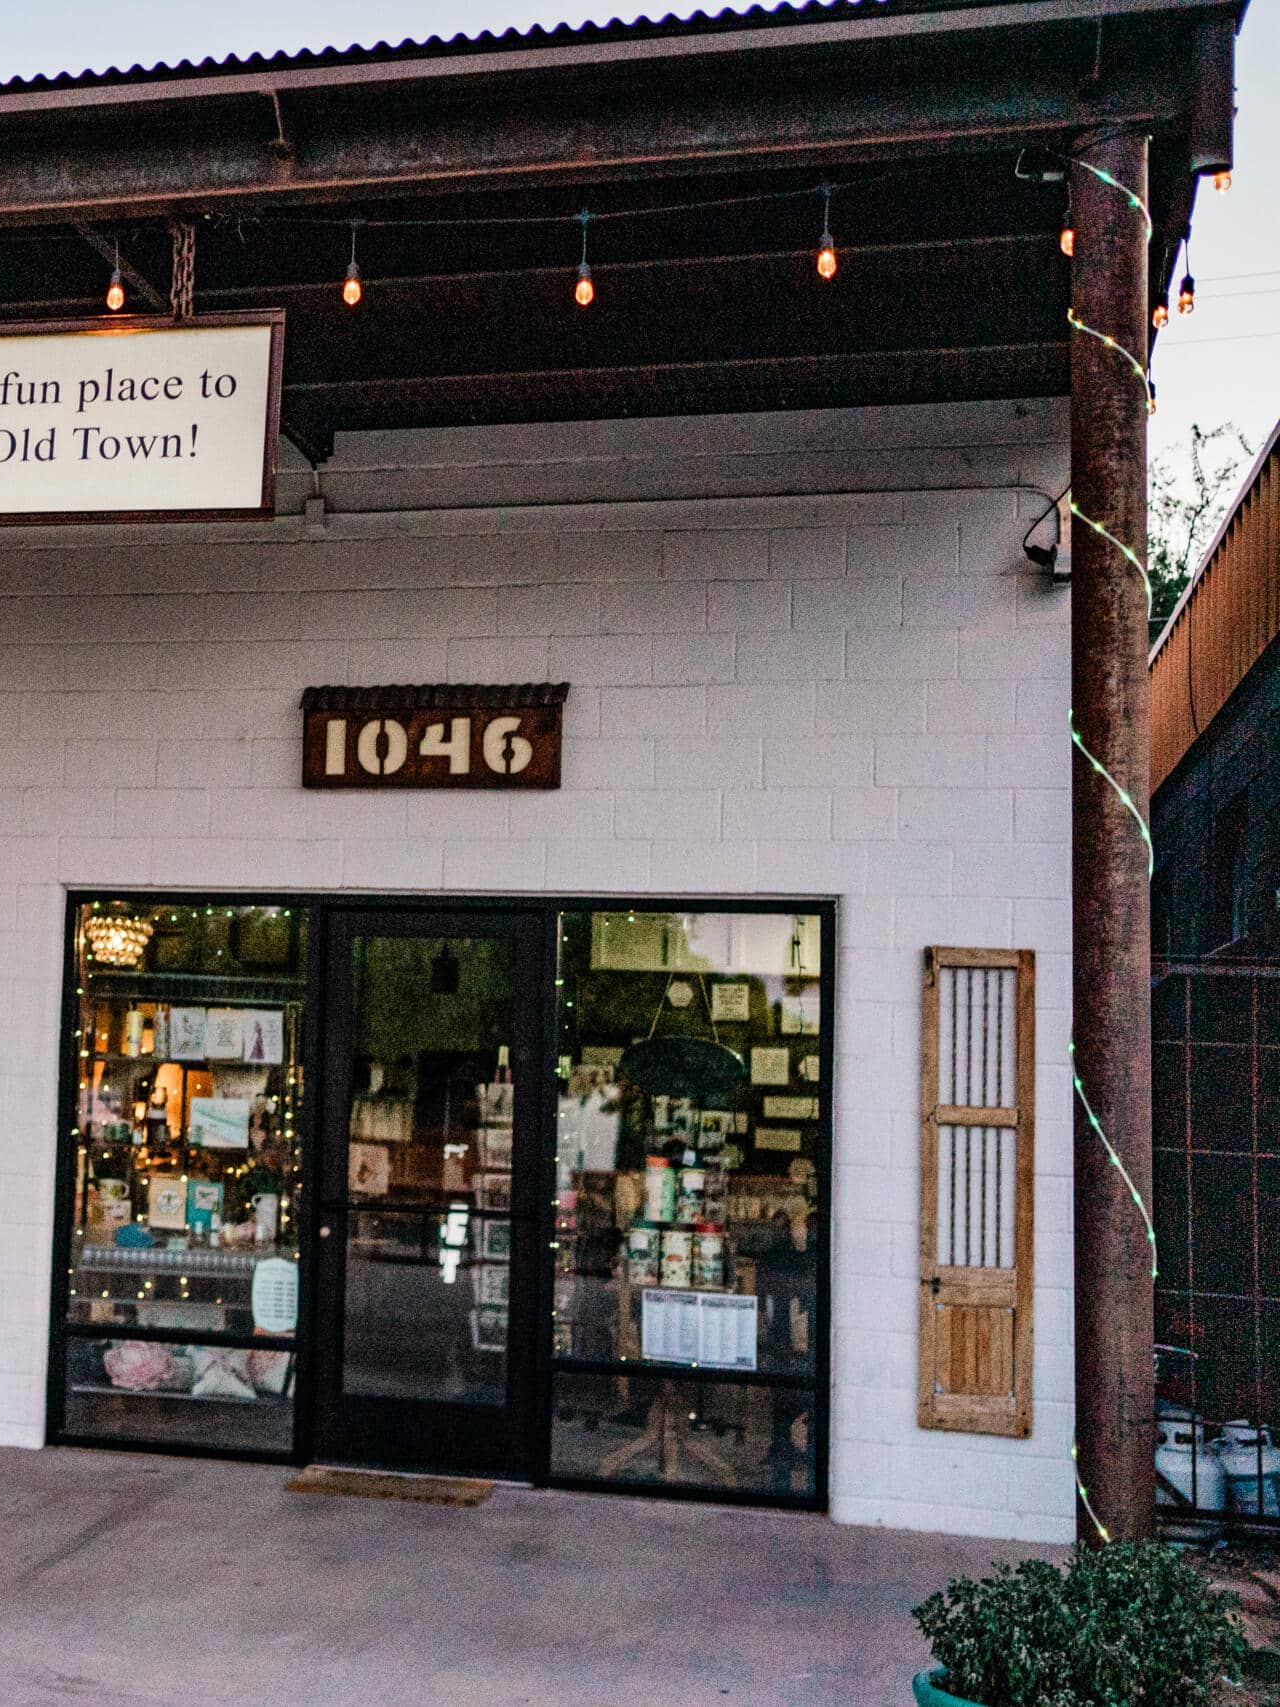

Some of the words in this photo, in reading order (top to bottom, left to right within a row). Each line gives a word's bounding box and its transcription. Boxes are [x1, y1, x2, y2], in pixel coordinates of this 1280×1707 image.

[0, 371, 61, 406] fun
[78, 368, 184, 413] place
[199, 369, 238, 399] to
[73, 423, 200, 461] Town!
[325, 716, 533, 775] 1046
